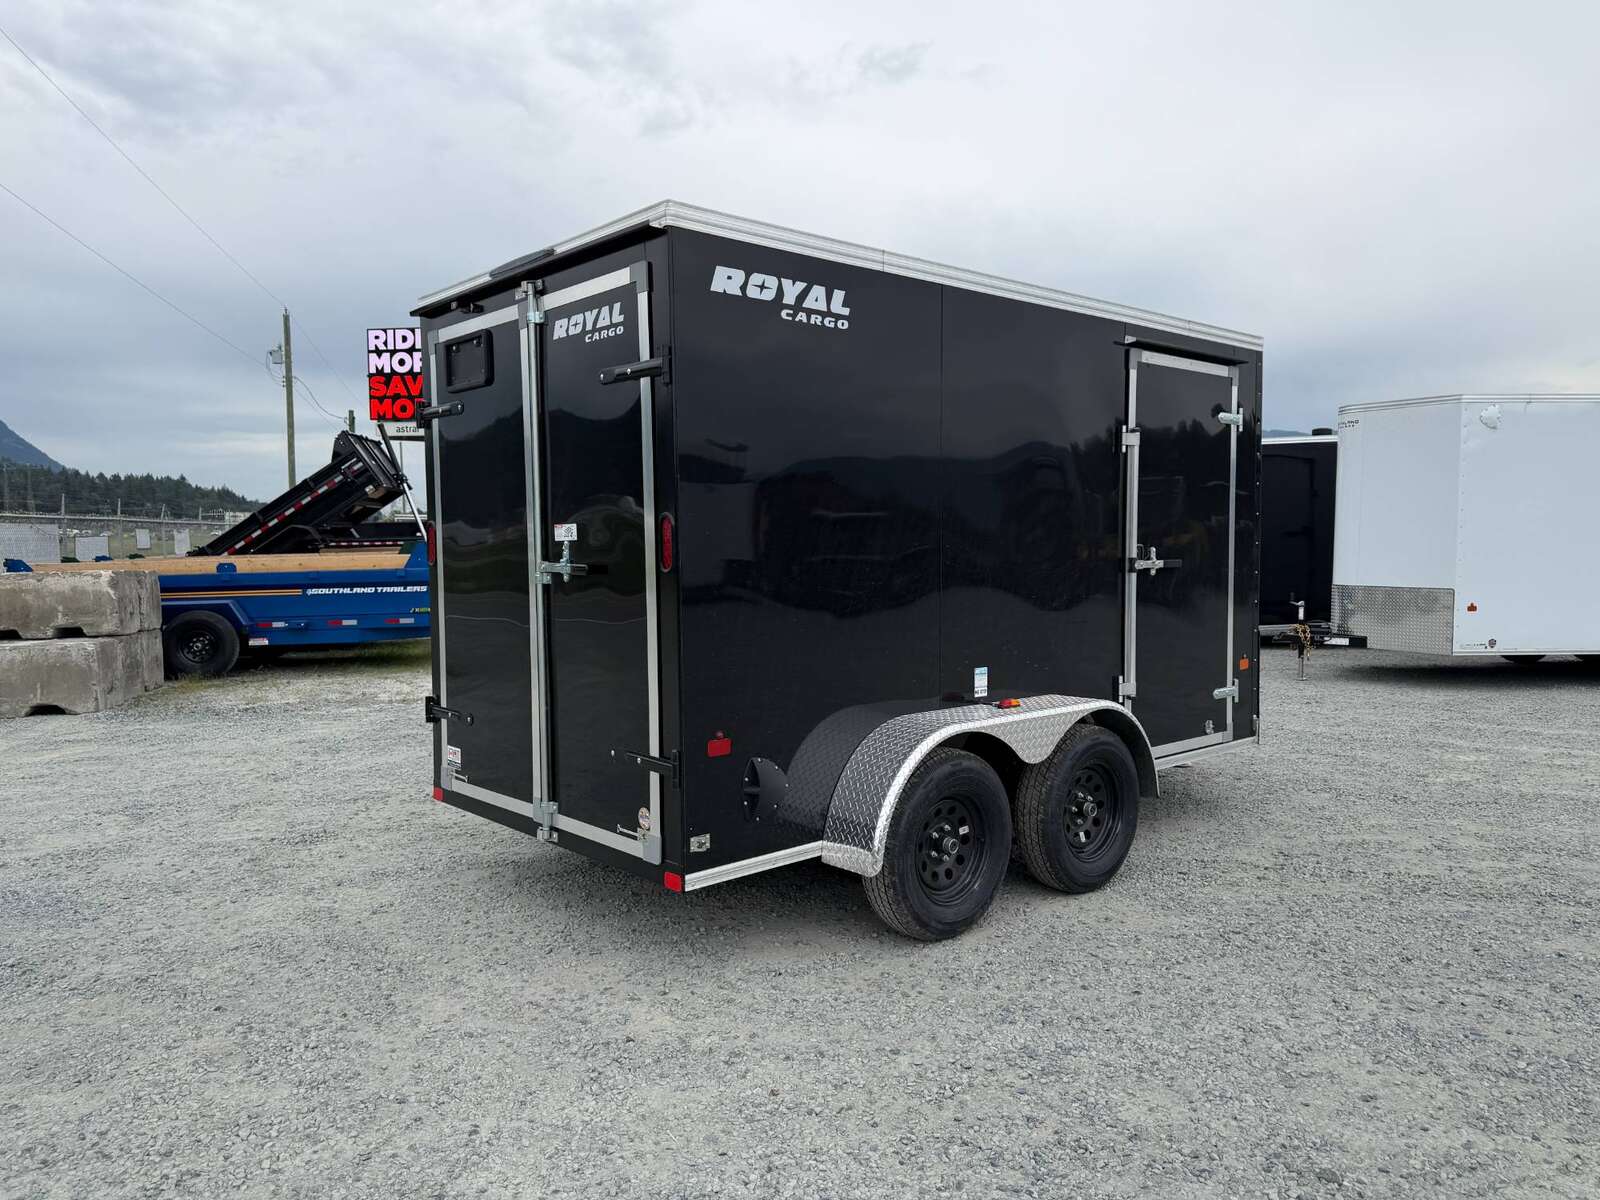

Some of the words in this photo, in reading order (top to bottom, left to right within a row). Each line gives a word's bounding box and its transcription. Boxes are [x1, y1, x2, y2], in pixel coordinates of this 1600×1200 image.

[710, 265, 851, 316] ROYAL
[553, 301, 625, 341] ROYAL
[780, 309, 849, 330] CARGO
[585, 325, 624, 343] CARGO
[371, 398, 424, 420] MO
[310, 587, 375, 595] SOUTHLAND
[376, 585, 427, 593] TRAILERS
